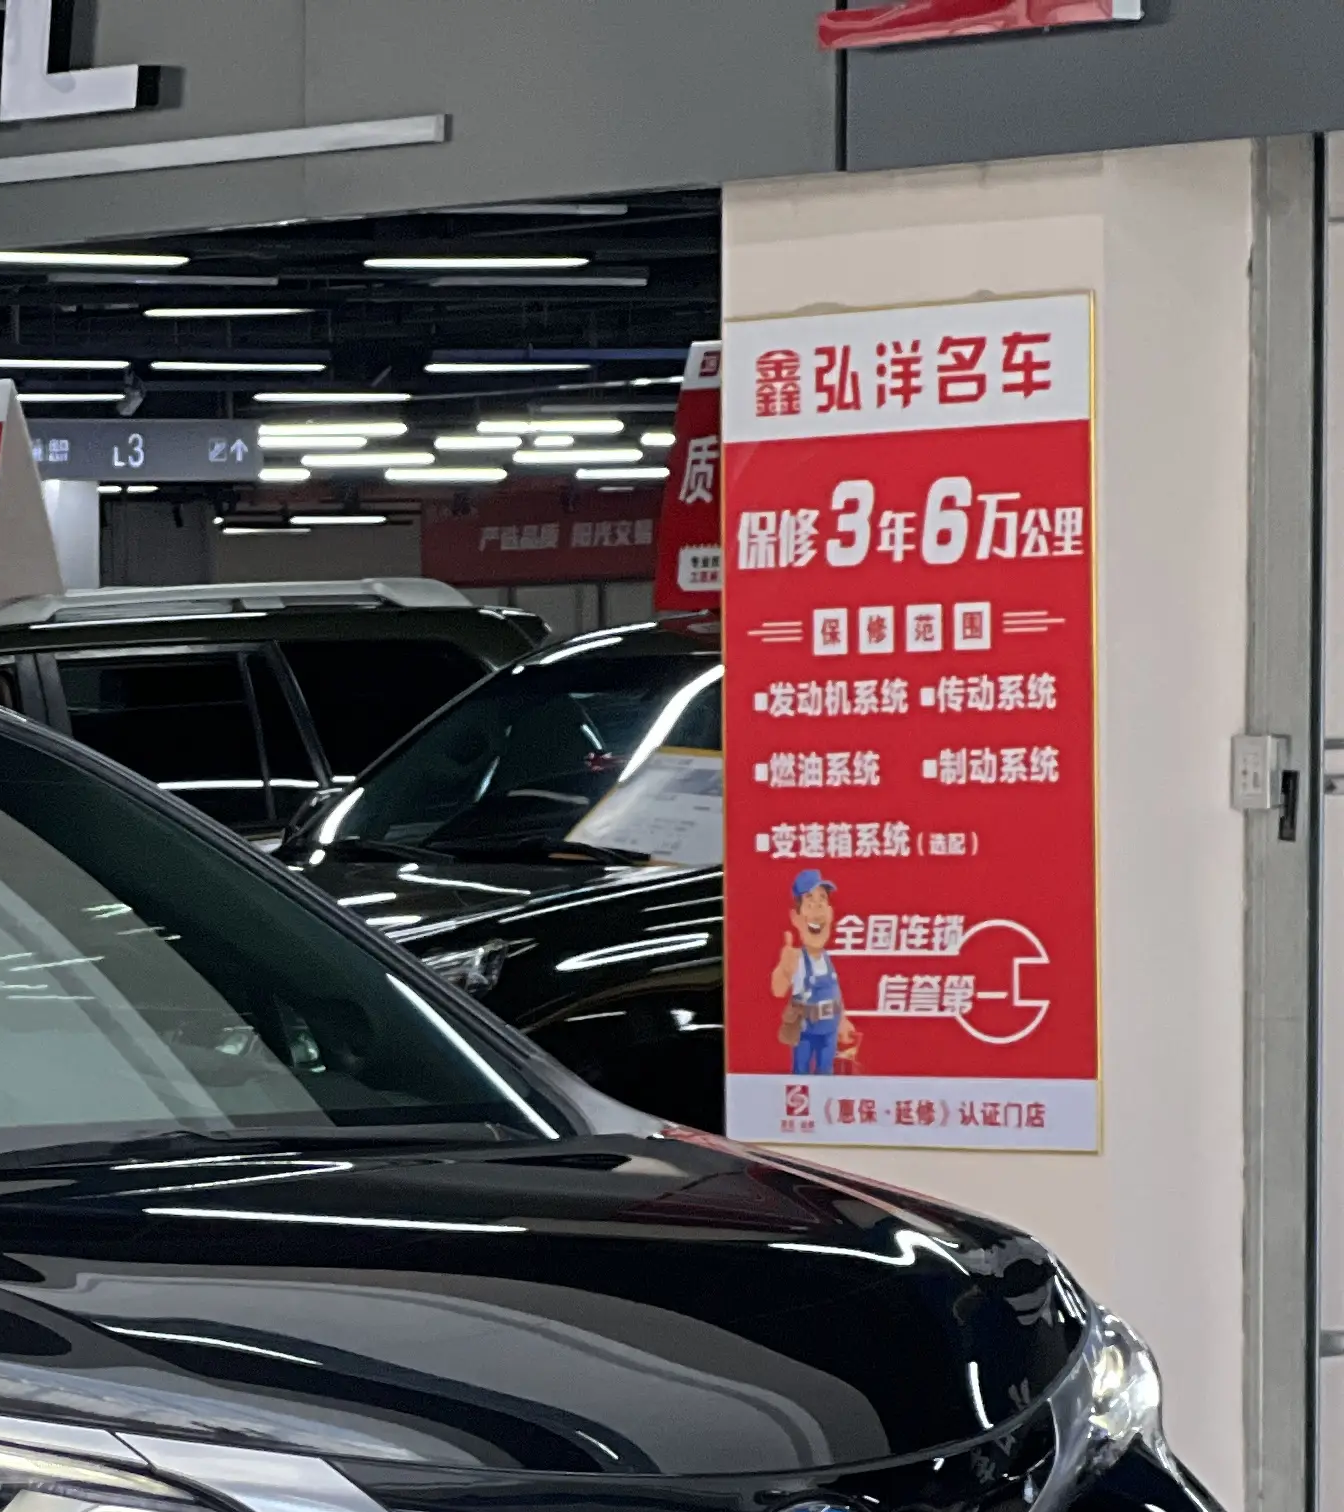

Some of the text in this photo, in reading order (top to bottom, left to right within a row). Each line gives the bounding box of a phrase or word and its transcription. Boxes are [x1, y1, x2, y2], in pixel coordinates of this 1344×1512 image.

[755, 332, 1052, 417] 鑫弘洋名车
[737, 475, 1084, 571] 保修3年6万公里
[768, 672, 1057, 718] 发动机系统 传动系统
[769, 746, 1060, 788] 燃油系统 制动系统
[771, 820, 911, 859] 变速箱系统
[834, 914, 965, 953] 全国连锁
[876, 974, 1009, 1015] 信誉第一
